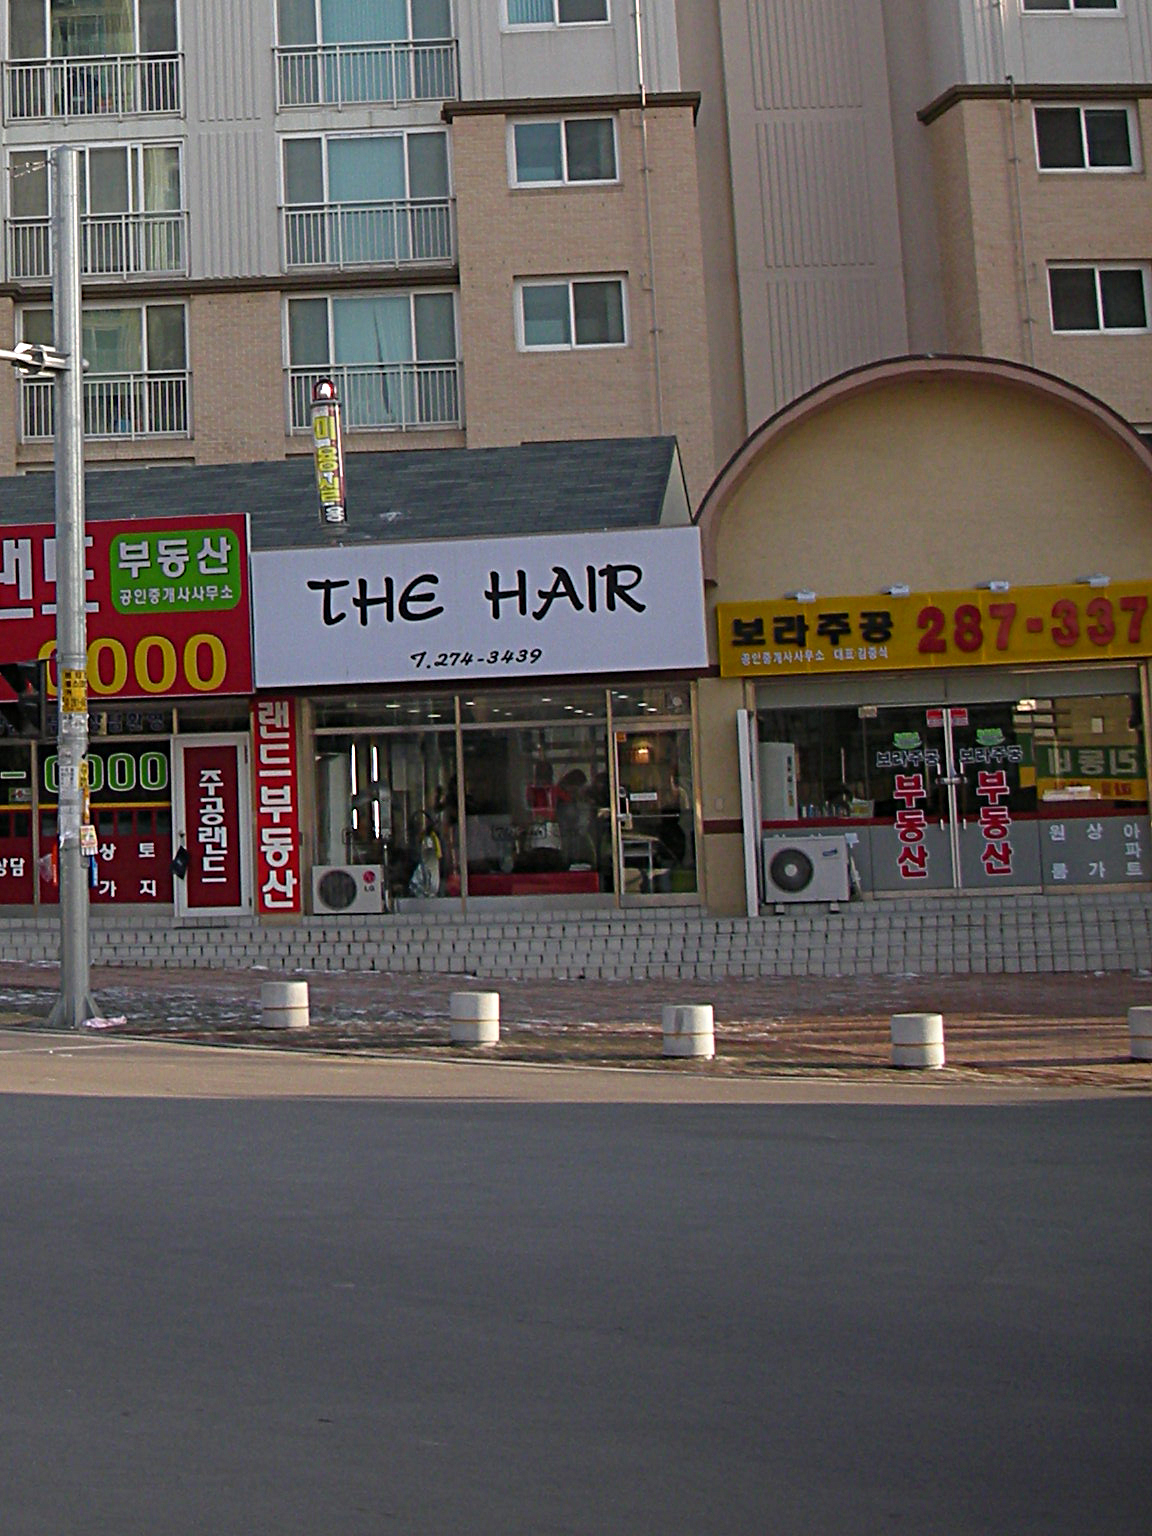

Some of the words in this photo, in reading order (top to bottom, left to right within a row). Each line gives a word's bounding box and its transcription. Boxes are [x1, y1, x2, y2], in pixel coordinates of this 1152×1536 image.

[118, 536, 231, 579] 부동산
[120, 584, 233, 606] 공인중개사사무소
[307, 574, 444, 626] THE
[484, 564, 647, 621] HAIR
[731, 610, 895, 647] 보라주공
[917, 595, 1148, 654] 287-337
[876, 749, 940, 768] 보라주공
[959, 745, 1023, 763] 보라주공
[198, 769, 229, 884] 주공랜드
[258, 701, 298, 909] 랜드부동산
[893, 773, 929, 879] 부동산
[976, 770, 1014, 875] 부동산
[99, 843, 117, 898] 상가
[138, 842, 157, 897] 토지
[1123, 822, 1144, 877] 아파트
